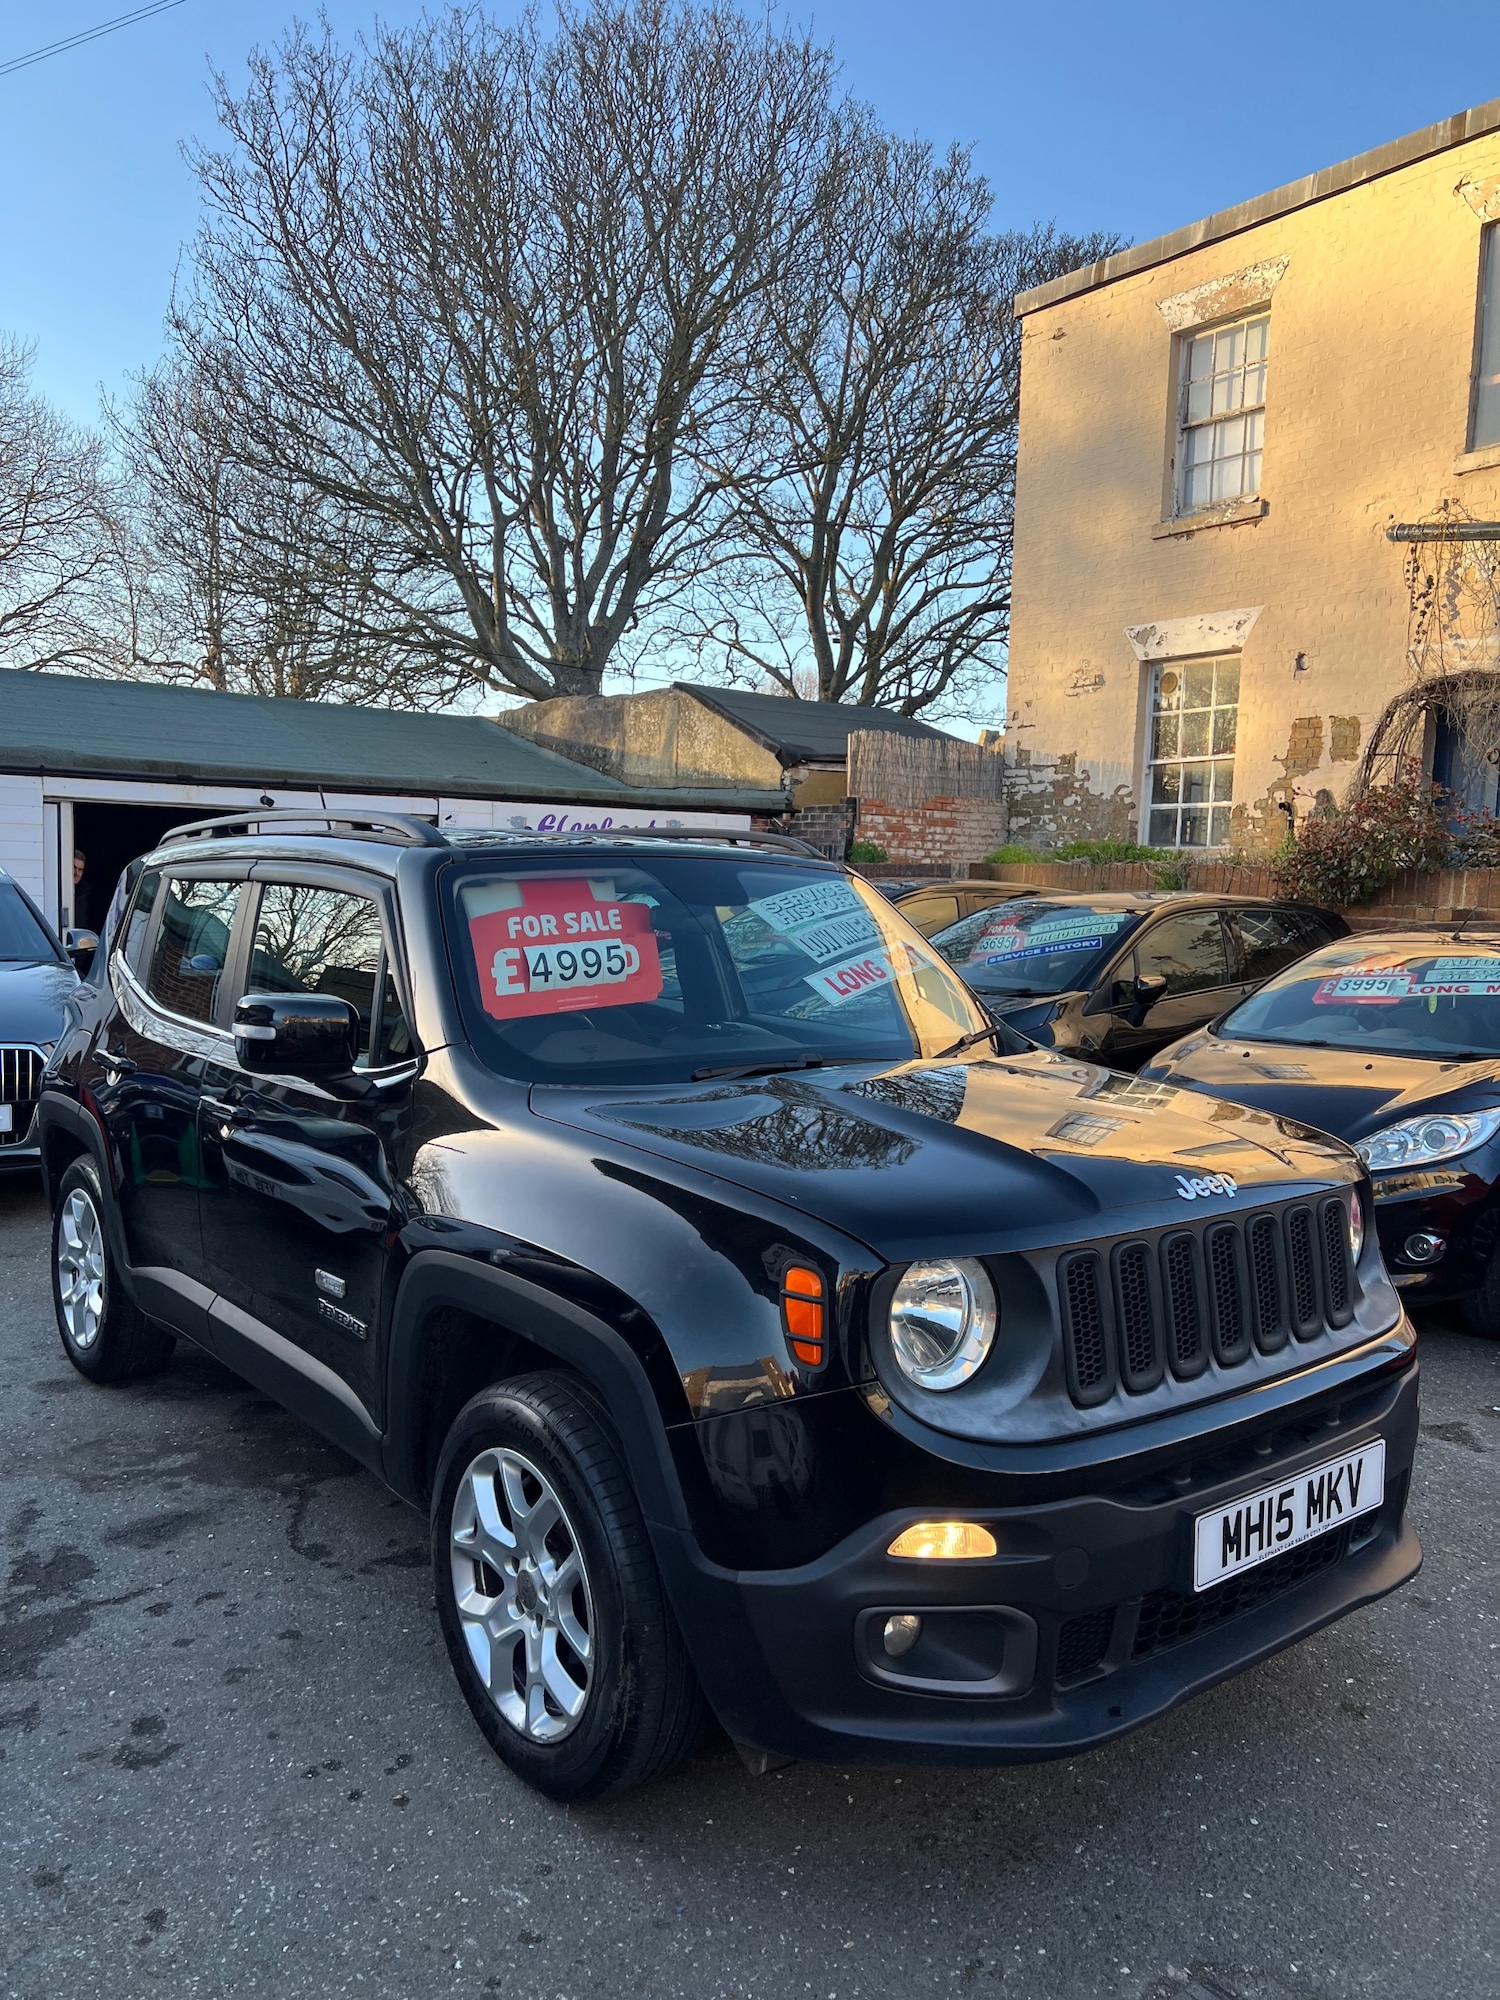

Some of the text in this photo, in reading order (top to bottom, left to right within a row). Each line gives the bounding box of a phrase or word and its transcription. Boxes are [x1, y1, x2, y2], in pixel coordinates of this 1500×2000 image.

[760, 883, 849, 914] SERVICE
[776, 894, 862, 926] HISTORY
[507, 909, 623, 939] FOR SALE
[986, 925, 1003, 935] FOR
[799, 928, 839, 959] LOW
[989, 939, 1098, 964] SERVICE HISTORY
[1438, 957, 1500, 967] AUTO
[824, 959, 887, 997] LONG
[1408, 985, 1470, 994] LONG
[1174, 1173, 1238, 1200] Jeep
[1221, 1458, 1364, 1569] MH15 MKV
